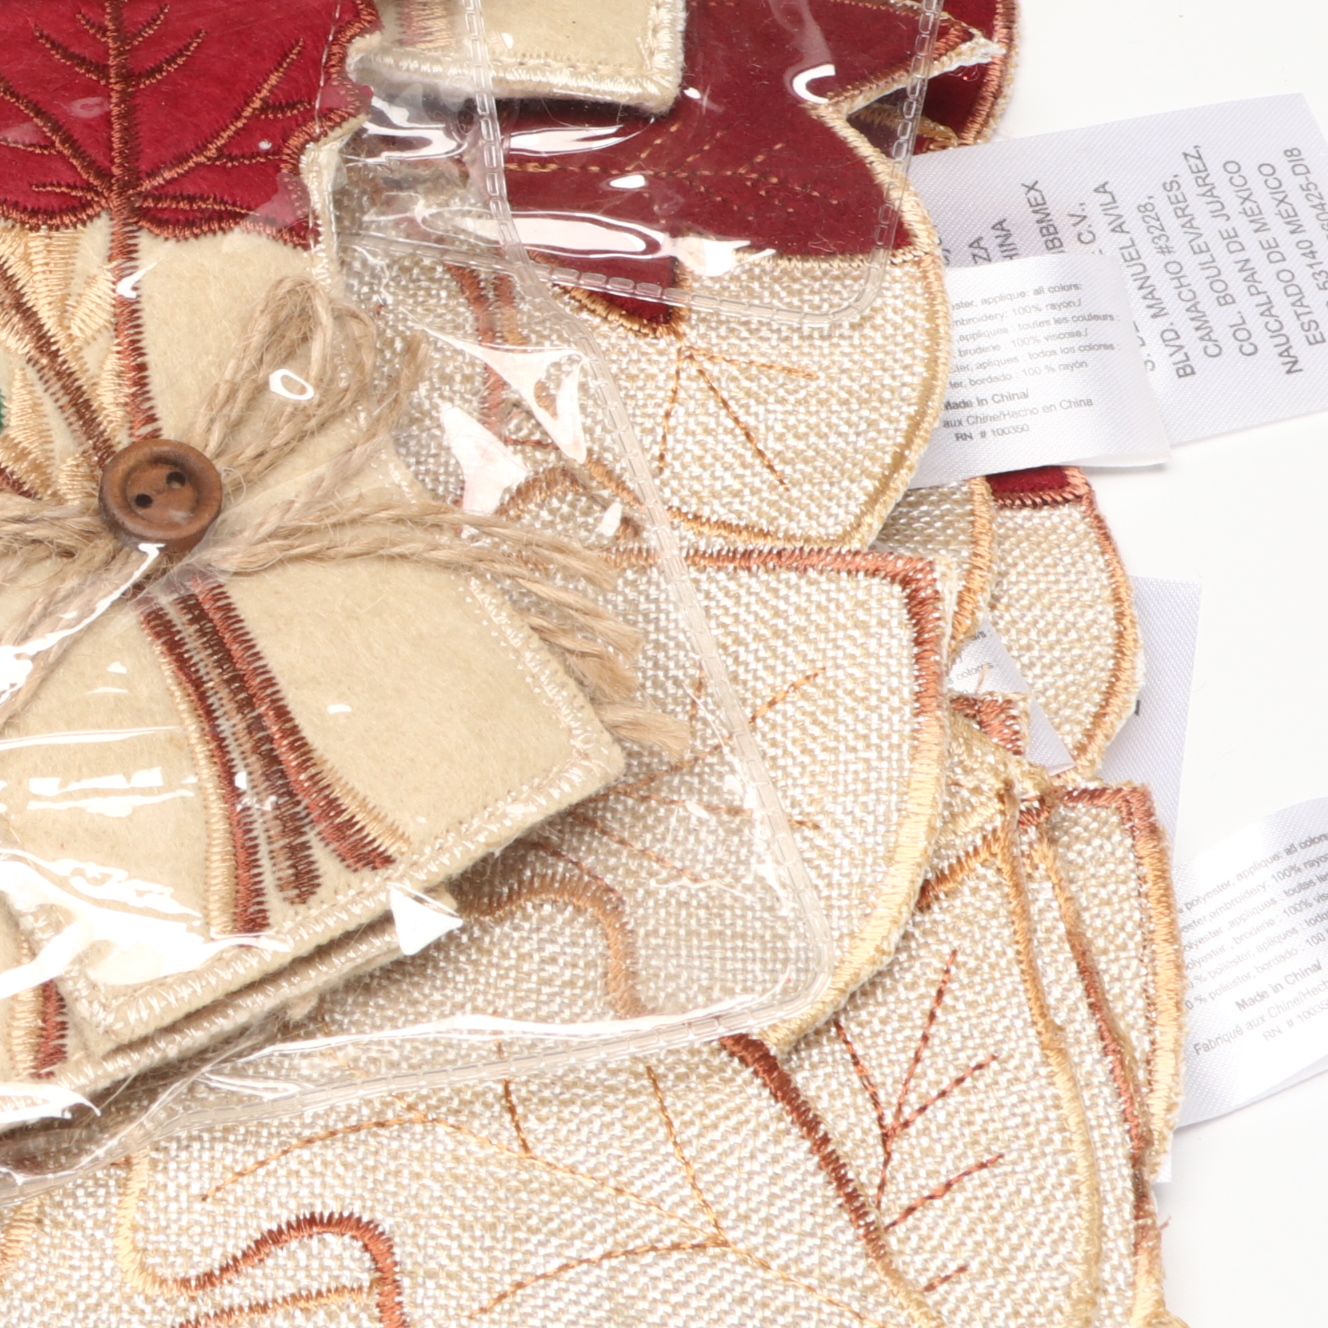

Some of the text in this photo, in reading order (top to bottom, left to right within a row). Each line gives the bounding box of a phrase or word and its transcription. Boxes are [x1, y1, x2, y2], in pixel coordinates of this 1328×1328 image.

[1092, 179, 1132, 236] AVILA
[1218, 226, 1247, 256] DE
[1258, 236, 1288, 264] DE
[1118, 236, 1170, 320] MANUEL
[1013, 304, 1043, 316] 100%
[1163, 259, 1224, 359] CAMACHO
[1233, 256, 1304, 376] NAUCALPAN
[1274, 267, 1327, 347] ESTADO
[1159, 322, 1198, 380] BLVD.
[1228, 310, 1260, 358] COL.
[1059, 396, 1094, 411] China
[1234, 990, 1271, 1013] Made
